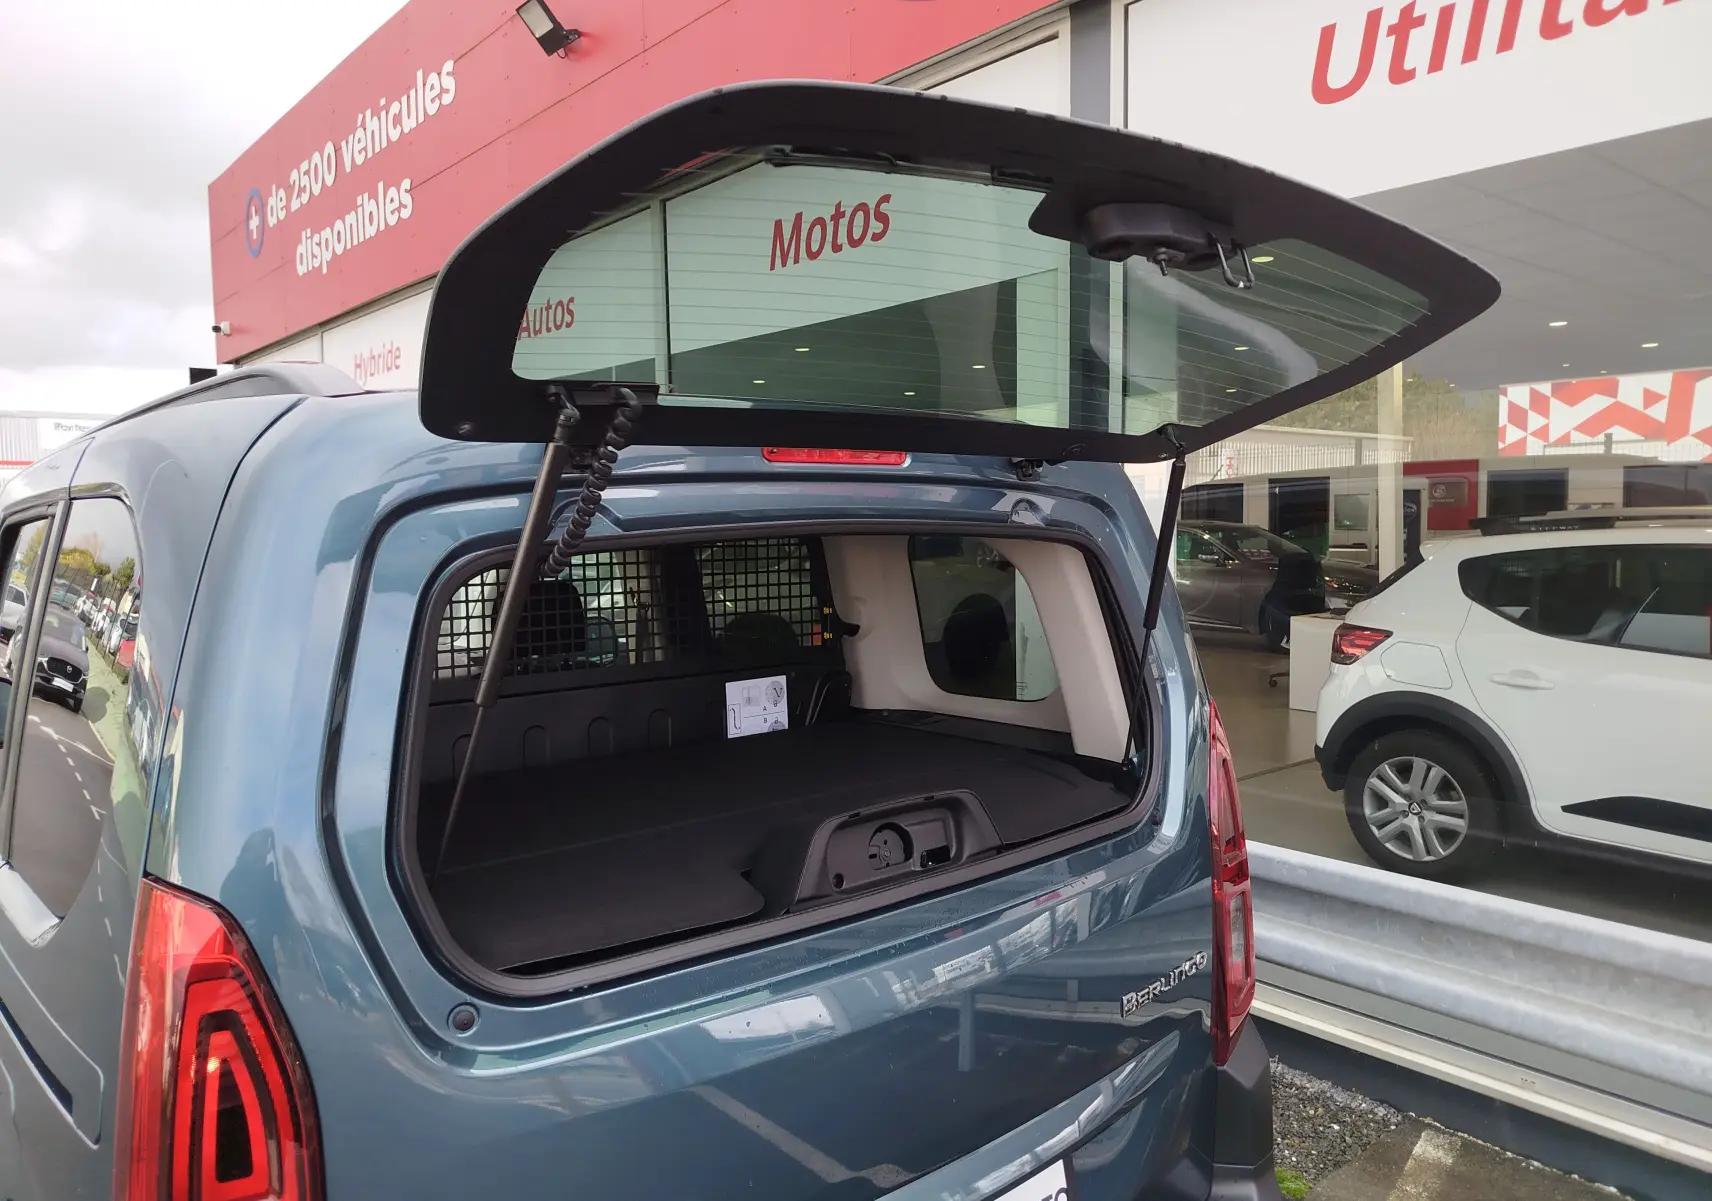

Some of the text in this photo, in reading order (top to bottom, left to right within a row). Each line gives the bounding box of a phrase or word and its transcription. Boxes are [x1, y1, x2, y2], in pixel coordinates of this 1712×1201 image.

[1312, 0, 1684, 104] Utili
[267, 184, 287, 227] de
[290, 141, 337, 212] 2500
[341, 60, 456, 174] véhicules
[296, 178, 413, 276] disponibles
[769, 194, 891, 271] Motos
[518, 296, 575, 340] Autos
[353, 342, 402, 383] Hybride
[1121, 951, 1208, 1018] BERLINGO
